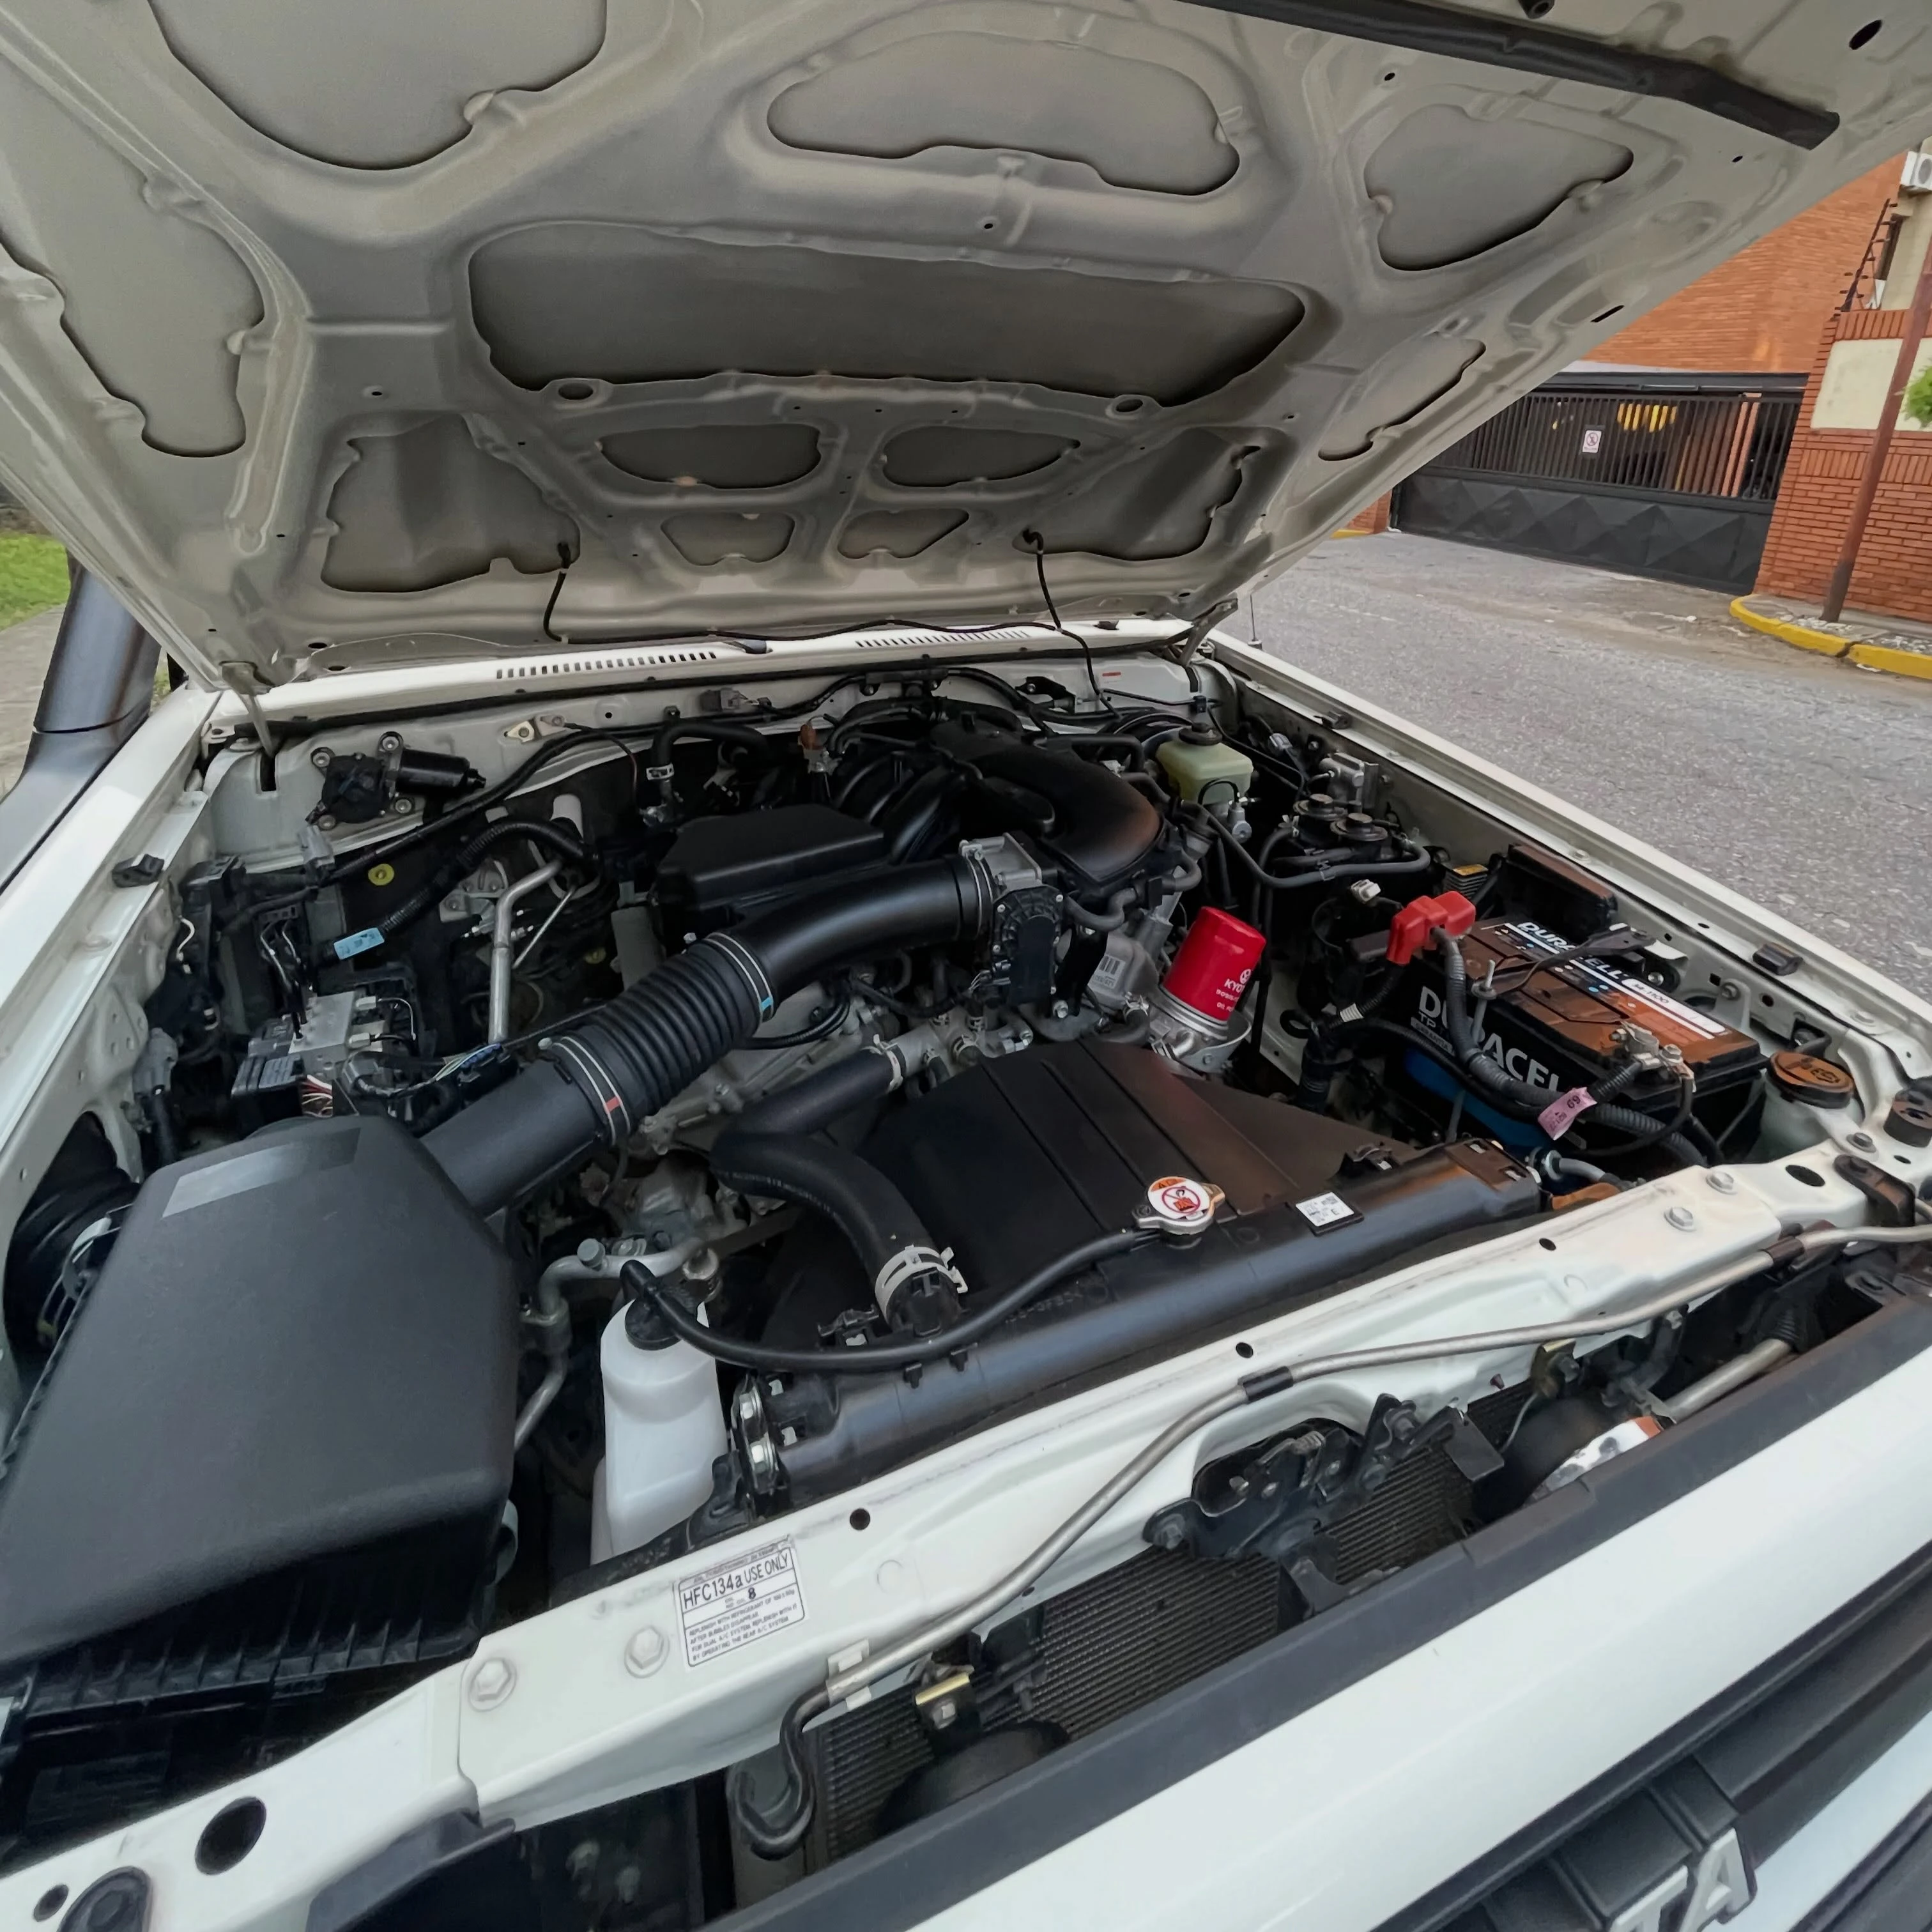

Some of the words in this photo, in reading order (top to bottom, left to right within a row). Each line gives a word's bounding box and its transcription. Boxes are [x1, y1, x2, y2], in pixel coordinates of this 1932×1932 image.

[1418, 1010, 1436, 1028] TP
[1567, 1095, 1581, 1108] 69
[683, 1574, 743, 1609] HFC134a
[744, 1563, 764, 1584] USE
[765, 1553, 788, 1575] ONLY
[748, 1587, 756, 1600] 8
